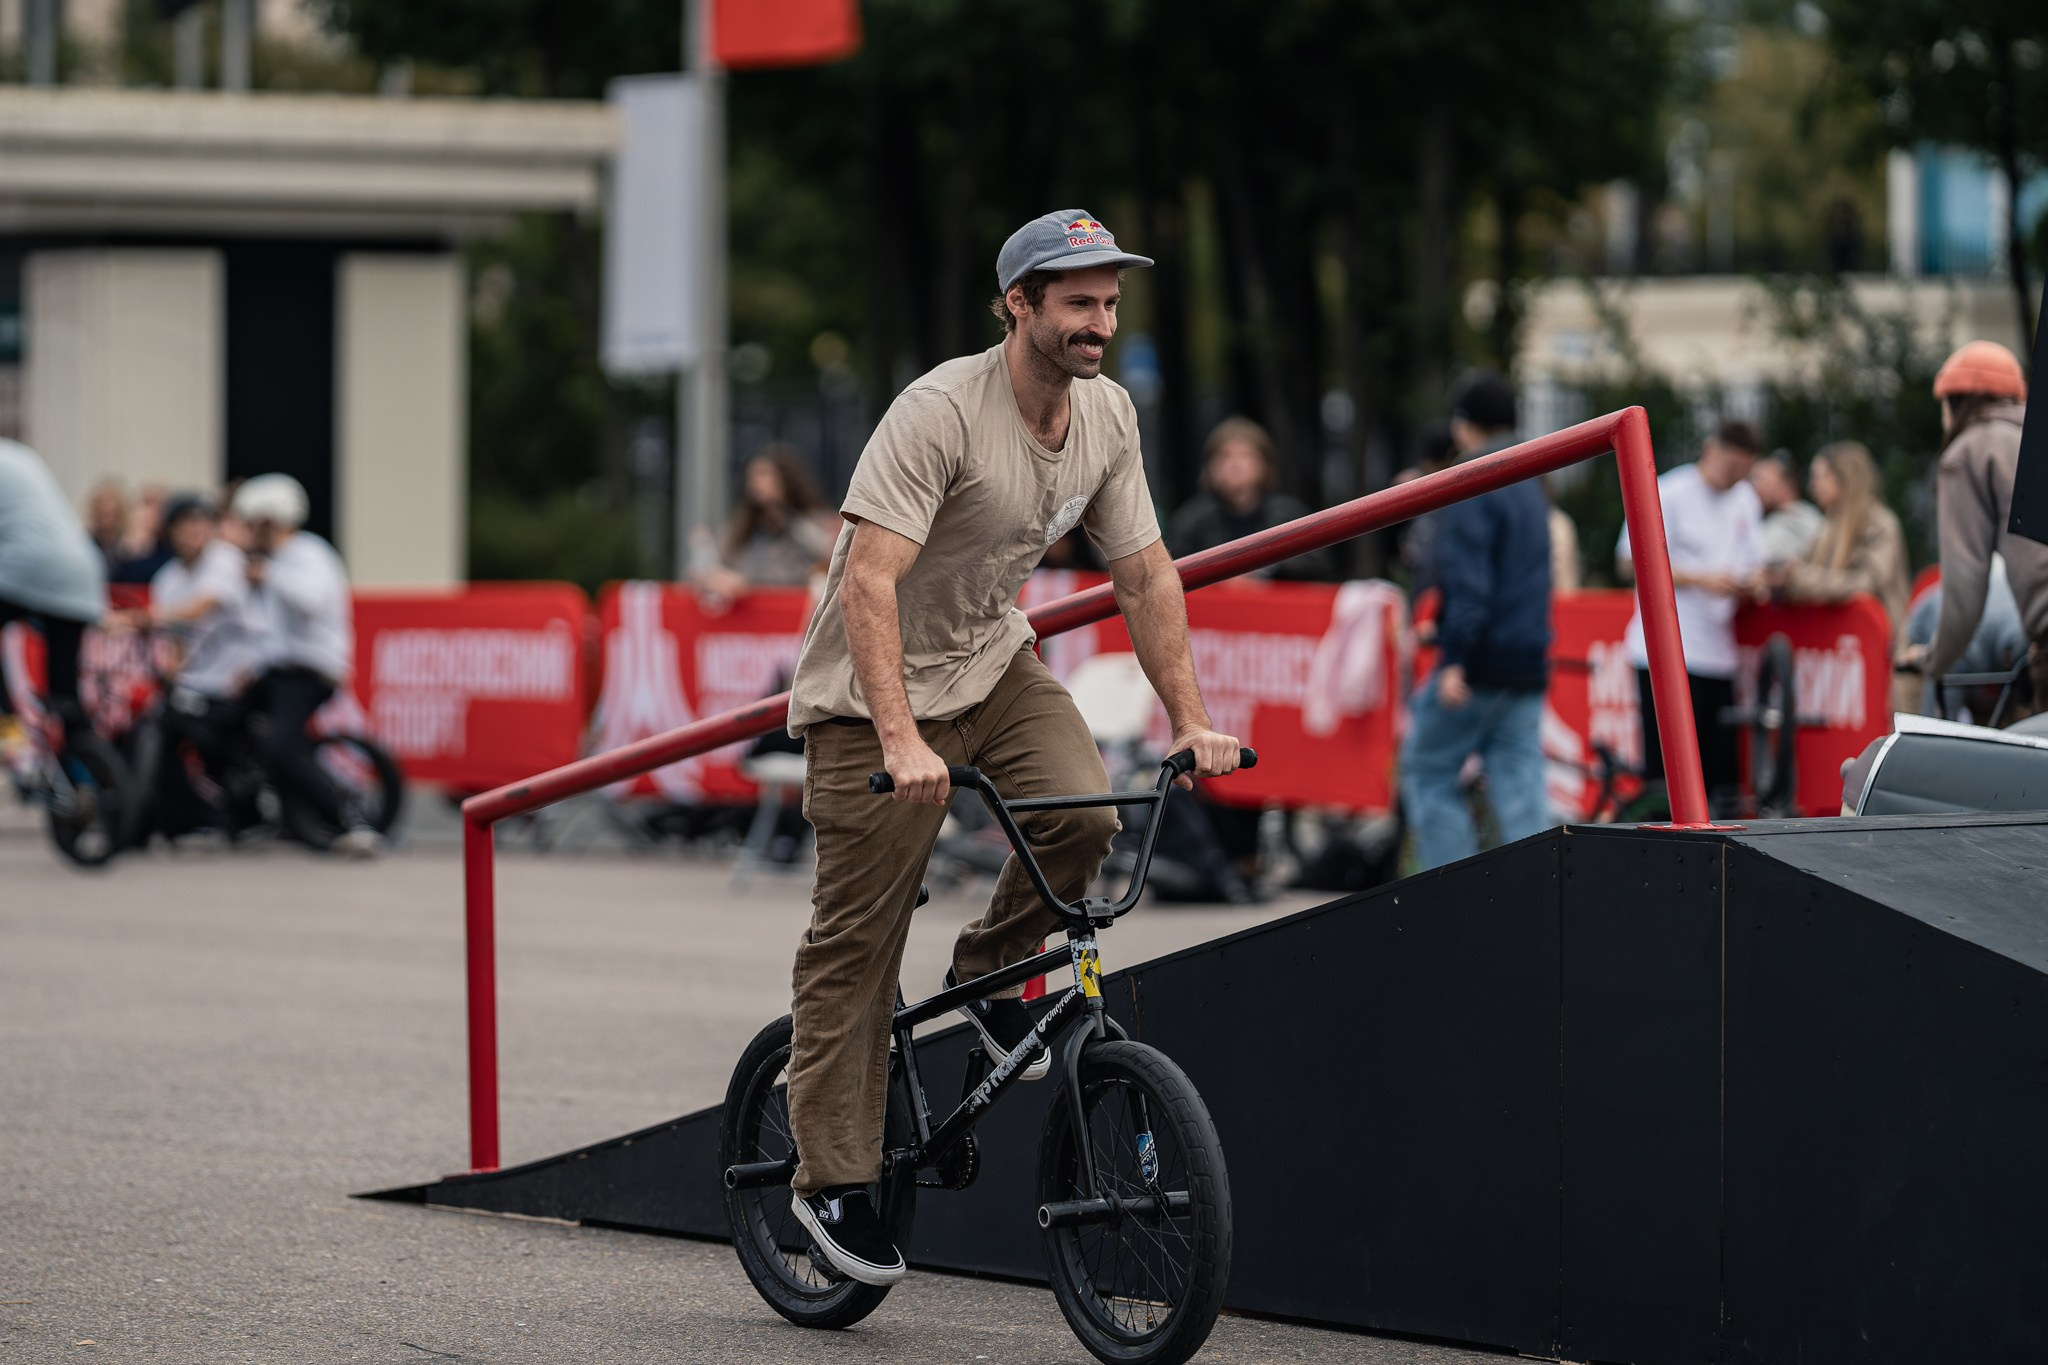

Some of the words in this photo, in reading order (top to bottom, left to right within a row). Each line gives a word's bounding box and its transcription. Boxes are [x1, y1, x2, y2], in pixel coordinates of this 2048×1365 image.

[1069, 234, 1095, 247] Red
[1090, 906, 1110, 916] FIEND
[1069, 936, 1097, 952] Fiend
